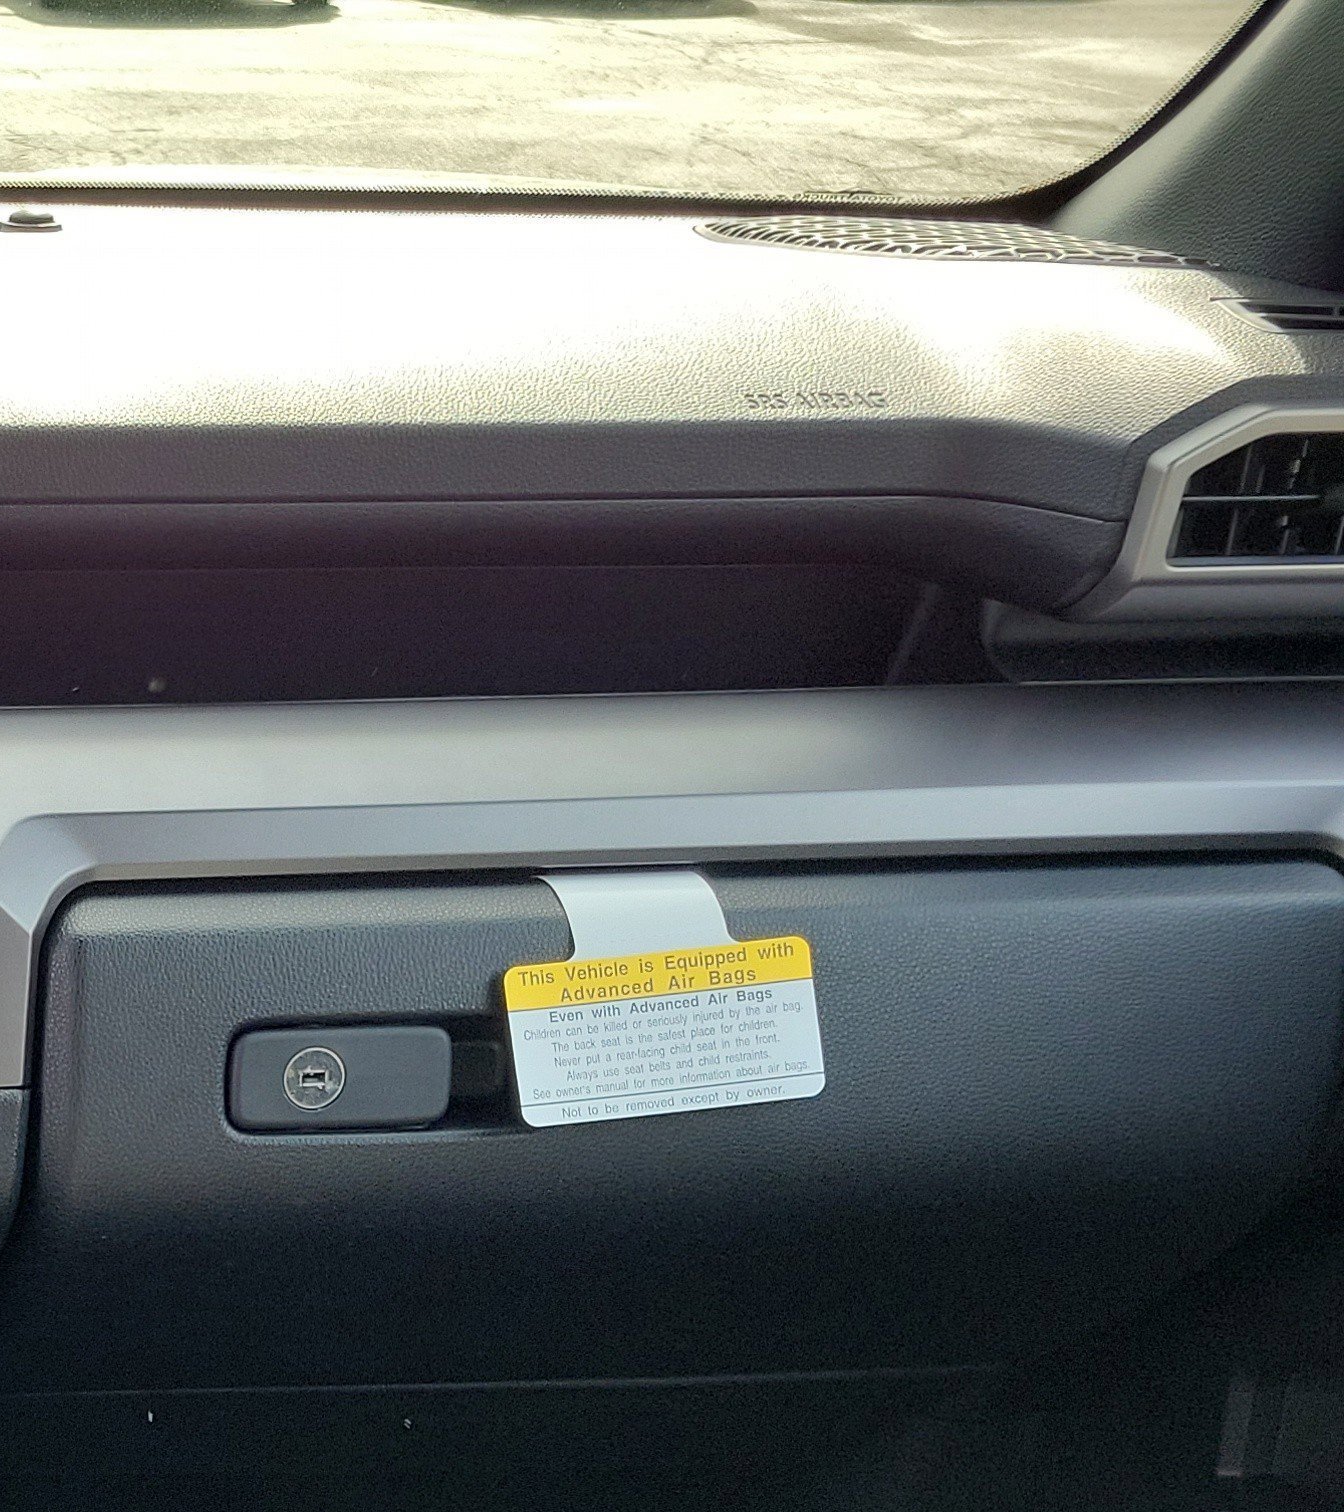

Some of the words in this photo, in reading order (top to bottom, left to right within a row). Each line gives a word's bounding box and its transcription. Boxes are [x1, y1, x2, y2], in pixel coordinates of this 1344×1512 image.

[744, 393, 788, 409] SRS
[796, 391, 889, 409] AIRBAG
[518, 968, 554, 986] This
[564, 960, 628, 981] Vehicle
[638, 958, 653, 973] is
[664, 947, 747, 973] Equipped
[757, 941, 794, 959] with
[559, 978, 654, 1002] Advanced
[667, 973, 696, 990] Air
[708, 966, 756, 987] Bags
[523, 1026, 560, 1040] Children
[565, 1026, 582, 1036] can
[586, 1022, 599, 1033] be
[603, 1019, 627, 1031] killed
[632, 1020, 641, 1028] or
[646, 1012, 687, 1029] seriously
[692, 1009, 724, 1023] injured
[728, 1007, 740, 1019] by
[745, 1004, 760, 1015] the
[765, 1003, 778, 1013] air
[782, 1000, 803, 1013] bag.
[549, 1008, 583, 1023] Even
[591, 1004, 620, 1018] with
[628, 995, 699, 1014] Advanced
[707, 992, 728, 1005] Air
[736, 987, 772, 1004] Bags
[551, 1040, 569, 1053] The
[573, 1037, 596, 1050] back
[600, 1035, 621, 1047] seat
[625, 1034, 633, 1044] is
[637, 1032, 653, 1043] the
[657, 1028, 685, 1041] safest
[689, 1025, 716, 1039] place
[720, 1023, 733, 1034] for
[737, 1018, 777, 1031] children.
[553, 1054, 580, 1068] Never
[585, 1053, 600, 1065] put
[605, 1054, 612, 1062] a
[616, 1045, 665, 1062] rear-facing
[669, 1043, 691, 1054] child
[695, 1040, 716, 1051] seat
[721, 1038, 730, 1048] in
[734, 1036, 750, 1046] the
[755, 1032, 779, 1044] front.
[532, 1088, 551, 1100] See
[555, 1084, 590, 1097] owner's
[595, 1080, 628, 1093] manual
[633, 1077, 646, 1088] for
[650, 1077, 673, 1086] more
[678, 1067, 730, 1084] information
[735, 1064, 762, 1077] about
[766, 1062, 780, 1073] air
[784, 1058, 810, 1072] bags.
[565, 1067, 598, 1083] Always
[602, 1068, 619, 1077] use
[624, 1063, 644, 1075] seat
[648, 1060, 671, 1072] belts
[675, 1057, 693, 1069] and
[697, 1054, 720, 1066] child
[725, 1048, 770, 1063] restraints.
[561, 1106, 581, 1119] Not
[587, 1105, 598, 1116] to
[604, 1102, 619, 1114] be
[625, 1096, 674, 1111] removed
[681, 1092, 719, 1107] except
[725, 1089, 739, 1101] by
[746, 1084, 785, 1097] owner.
